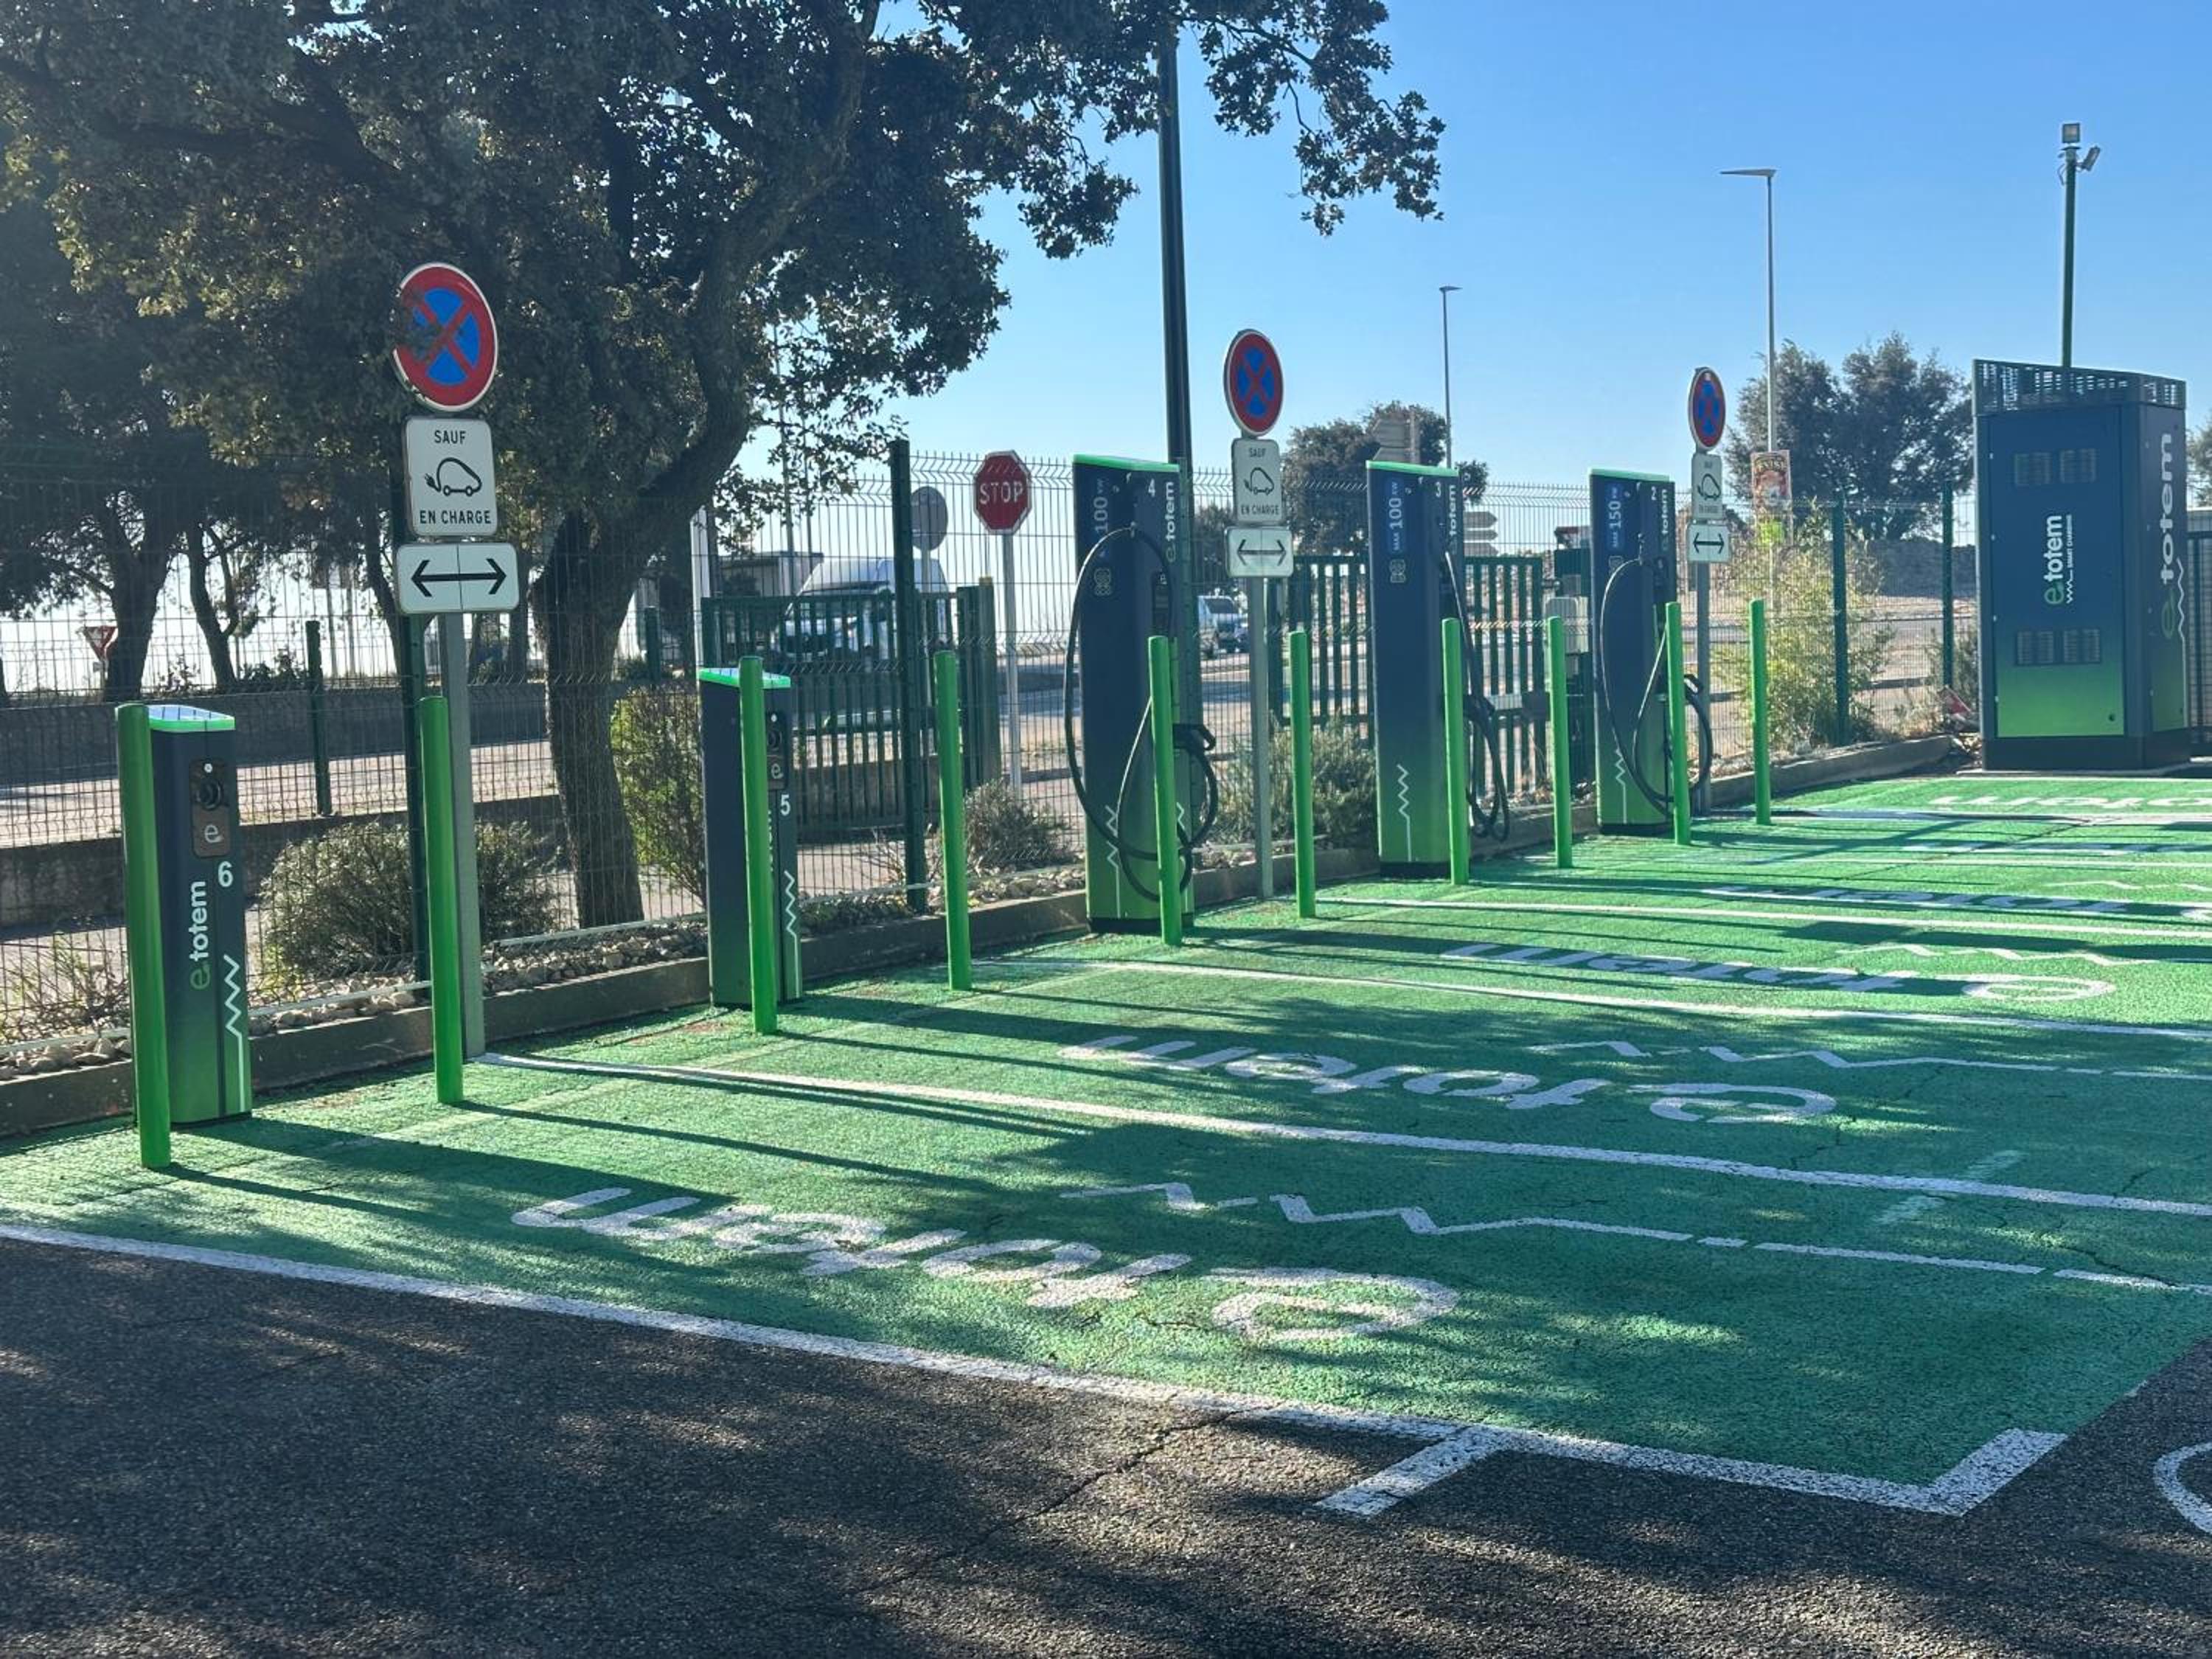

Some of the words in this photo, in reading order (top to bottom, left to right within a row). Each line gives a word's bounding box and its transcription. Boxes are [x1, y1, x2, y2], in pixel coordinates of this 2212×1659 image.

[434, 430, 466, 445] SAUF
[979, 480, 1023, 505] STOP
[1147, 478, 1156, 498] 4
[1435, 481, 1441, 498] 3
[419, 510, 437, 525] EN
[441, 509, 492, 525] CHARGE
[1093, 496, 1109, 534] 100
[1388, 497, 1403, 529] 100
[1608, 501, 1621, 529] 150
[779, 793, 791, 816] 5
[218, 860, 234, 887] 6
